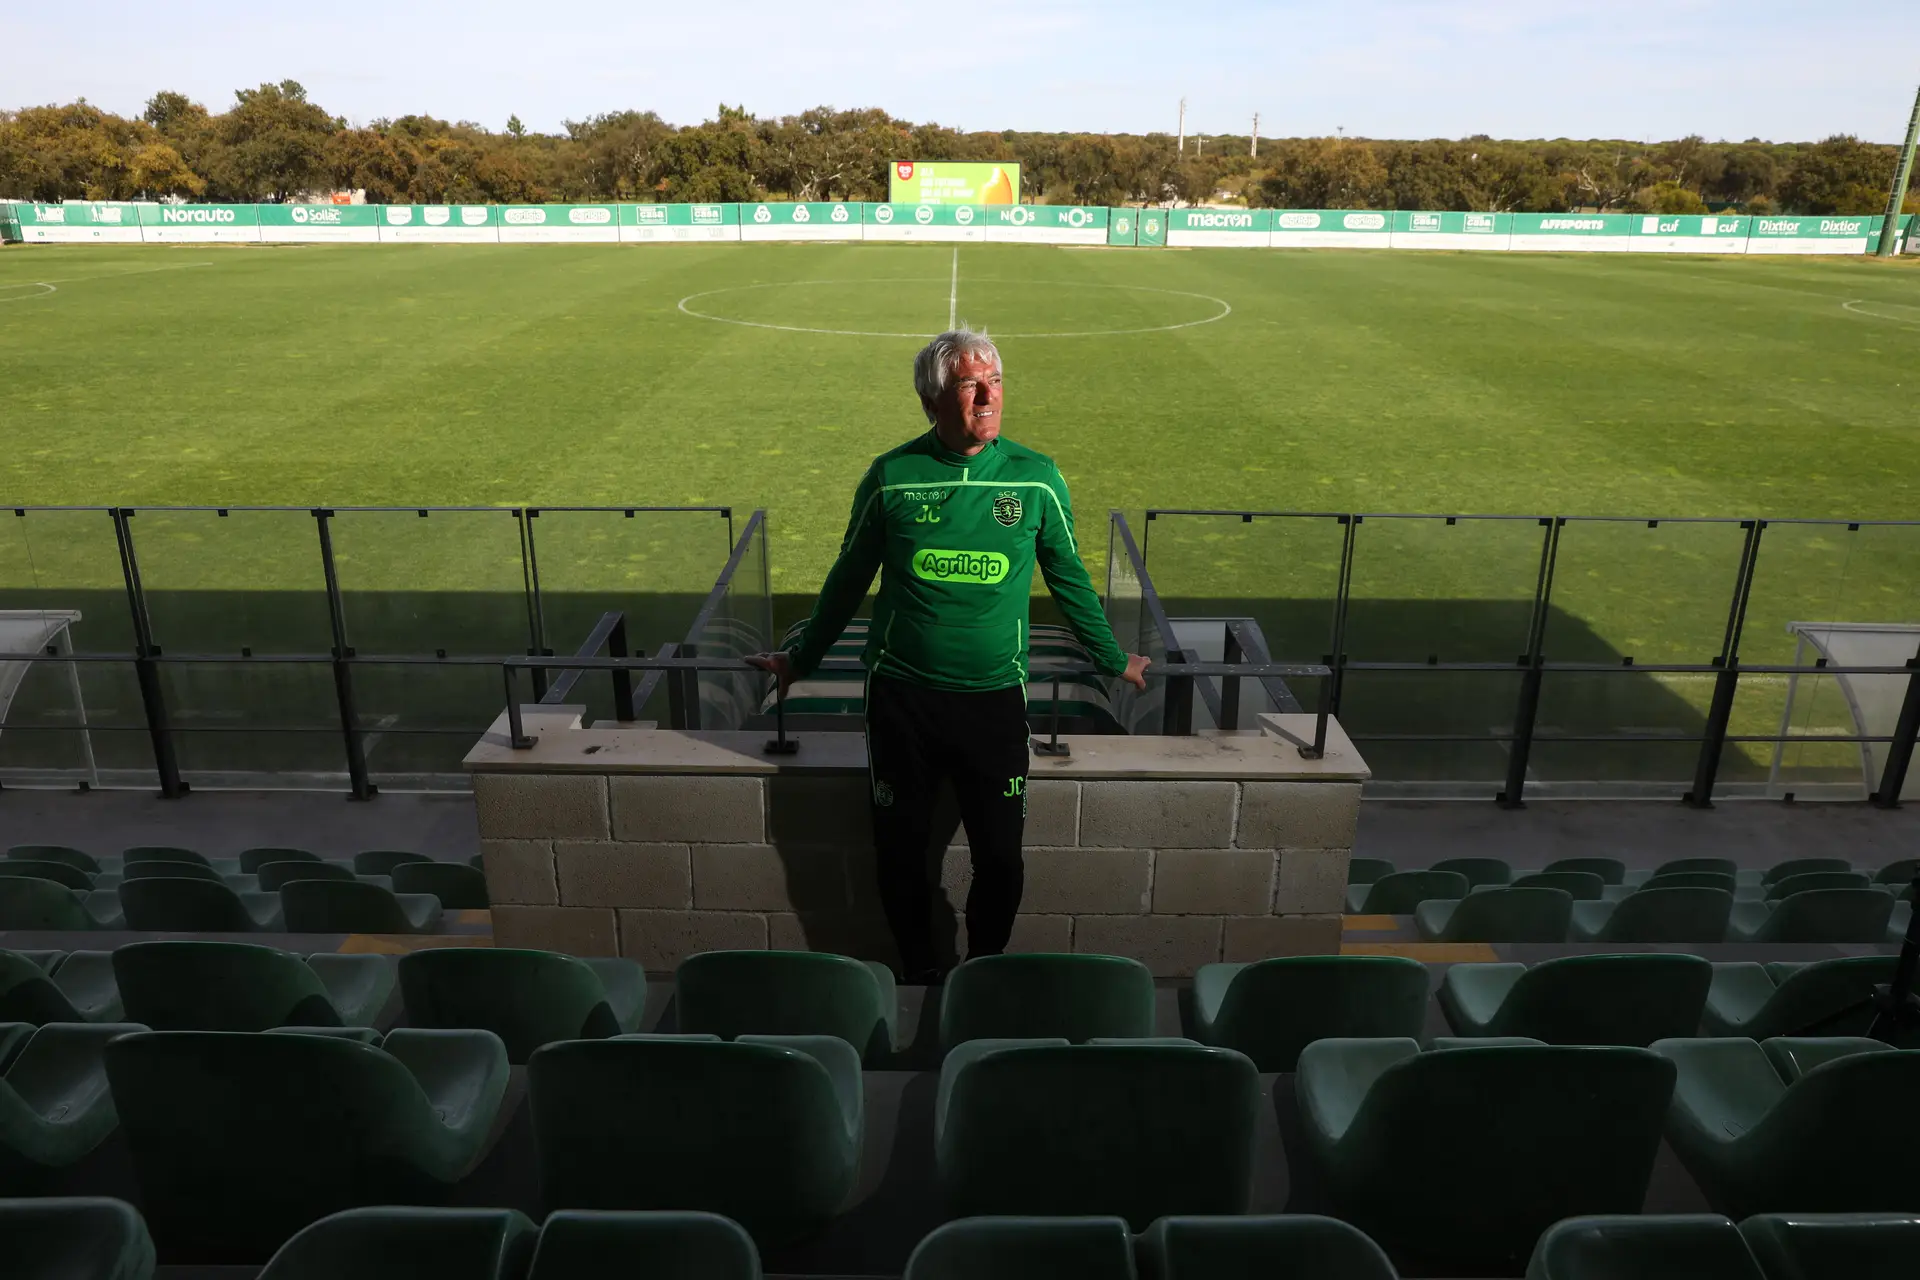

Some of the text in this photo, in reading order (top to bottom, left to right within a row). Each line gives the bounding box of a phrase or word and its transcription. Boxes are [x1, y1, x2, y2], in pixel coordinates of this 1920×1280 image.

[163, 208, 235, 223] Norauto
[309, 208, 341, 221] Sollac
[1000, 206, 1036, 225] NOS
[1059, 208, 1093, 227] NOS
[1187, 213, 1252, 227] macron
[1660, 218, 1680, 232] cuf
[1719, 219, 1740, 233] cuf
[1759, 220, 1800, 232] Dixtior
[1820, 220, 1861, 232] Dixtior
[904, 490, 947, 501] macron
[915, 504, 941, 523] JC
[921, 552, 1002, 580] Agriloja
[1003, 775, 1024, 798] JC
